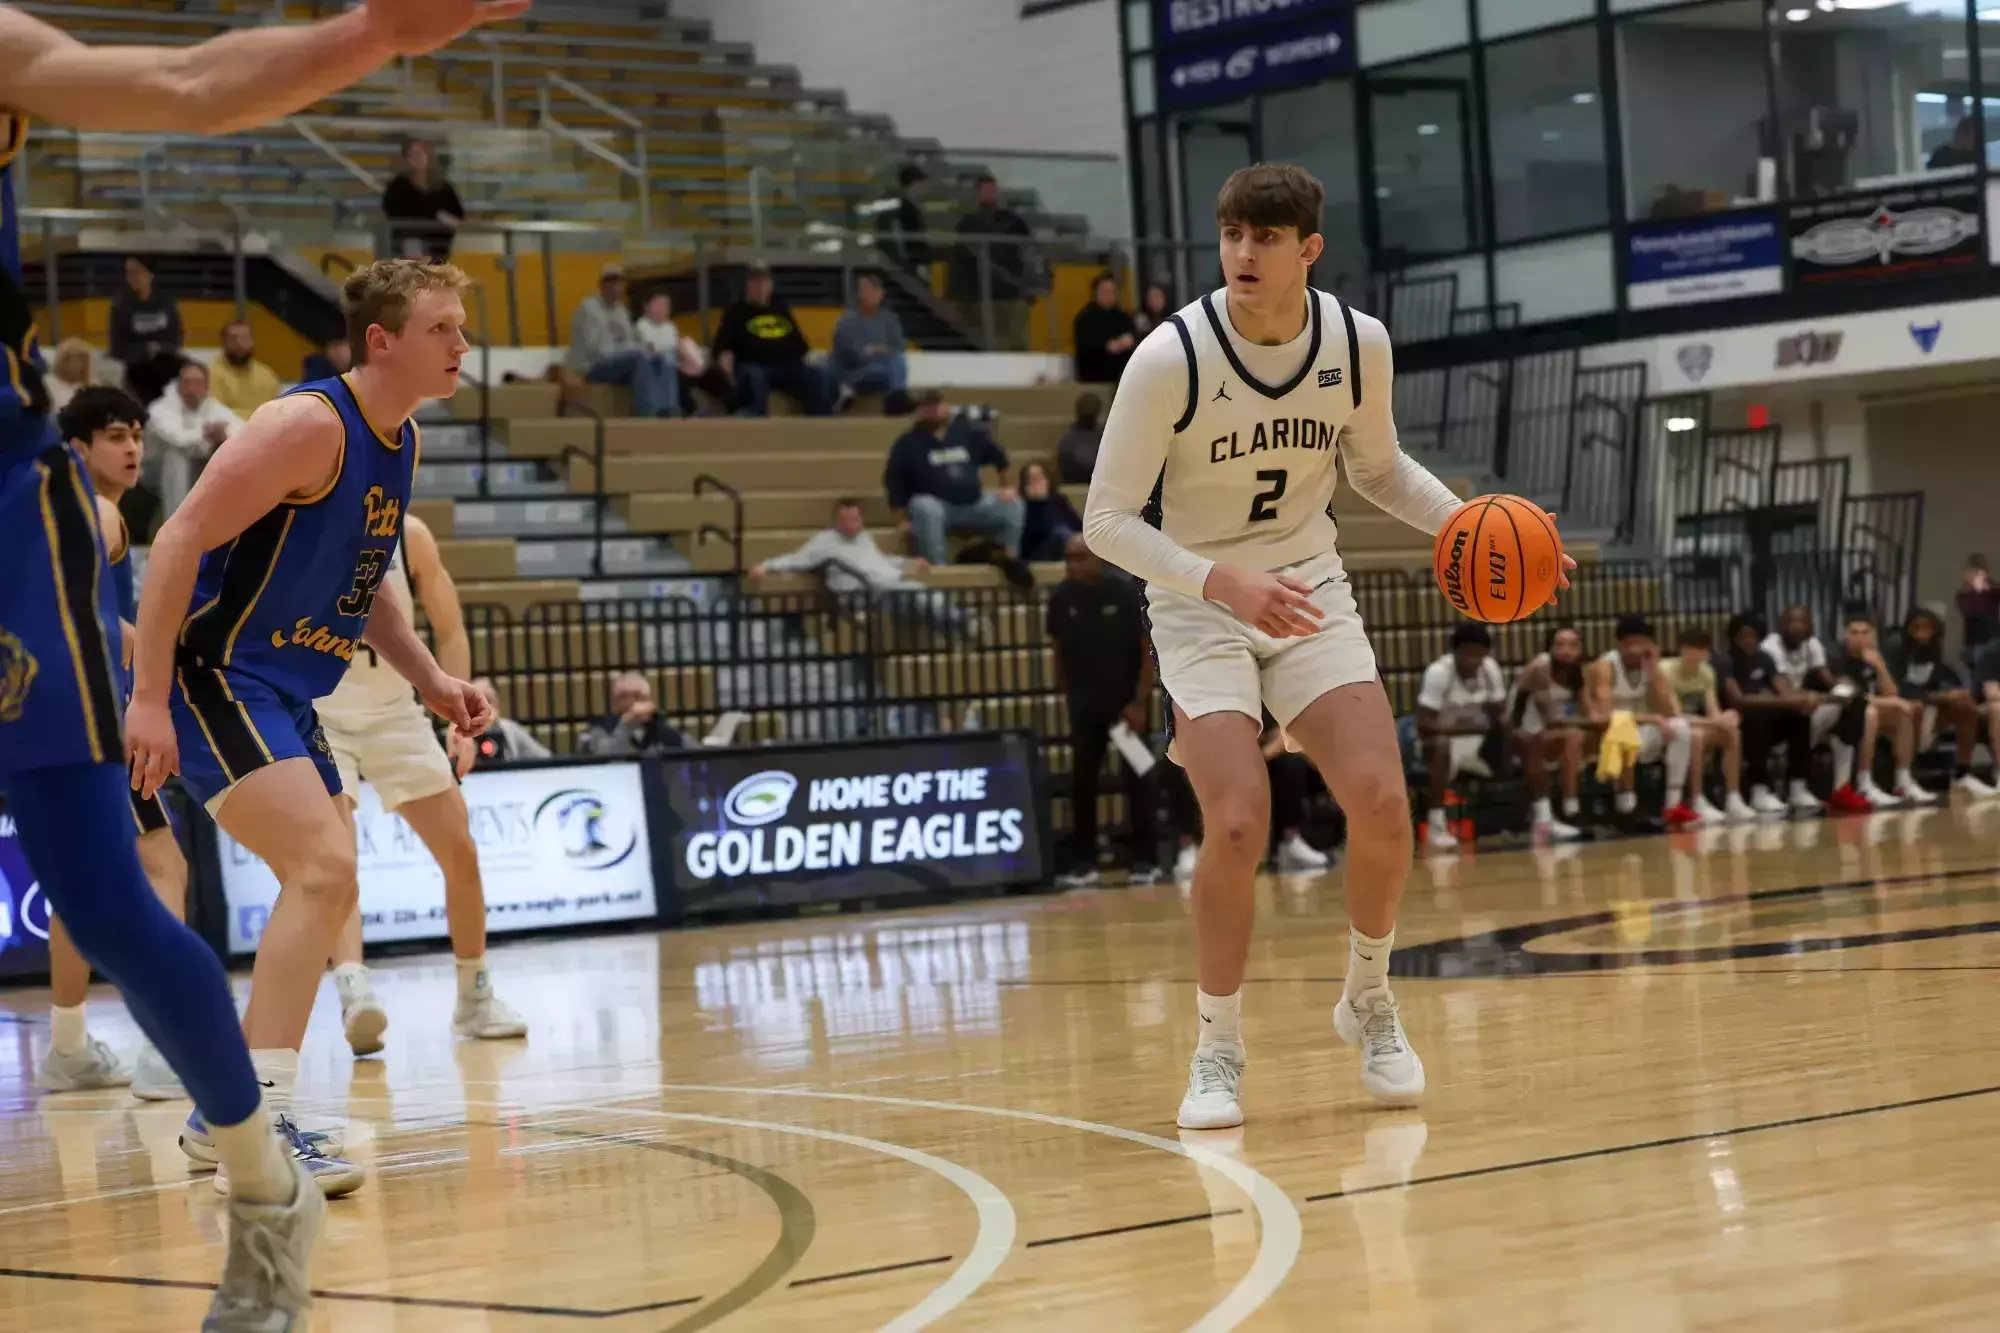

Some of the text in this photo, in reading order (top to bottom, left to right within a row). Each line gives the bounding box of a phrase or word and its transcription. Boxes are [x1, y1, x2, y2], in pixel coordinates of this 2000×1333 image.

[1318, 371, 1343, 385] PSAC
[1210, 418, 1335, 464] CLARION
[1248, 469, 1288, 523] 2
[1444, 530, 1470, 611] Wilson
[1489, 551, 1507, 601] EVO
[808, 767, 989, 812] HOME OF THE
[685, 808, 1025, 879] GOLDEN EAGLES
